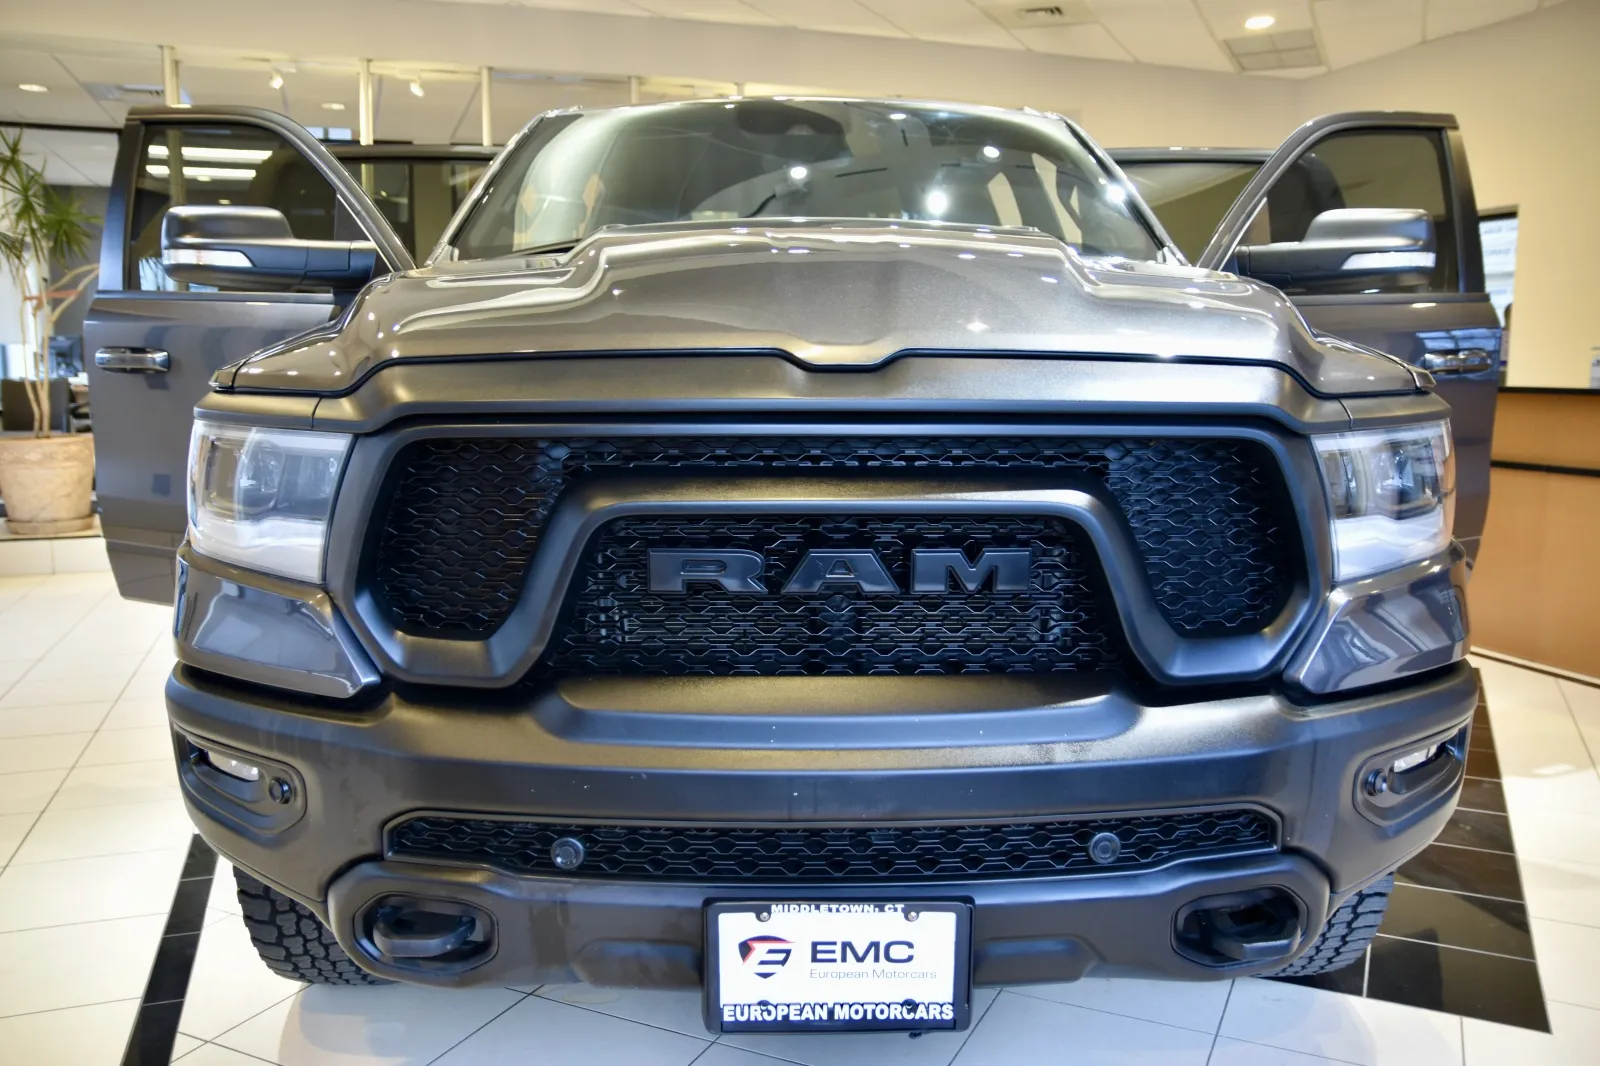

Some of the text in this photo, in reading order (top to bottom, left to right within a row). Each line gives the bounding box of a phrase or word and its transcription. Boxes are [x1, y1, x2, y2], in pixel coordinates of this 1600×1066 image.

[647, 548, 1032, 594] RAM
[884, 904, 905, 913] CT
[810, 940, 915, 964] EMC
[809, 968, 937, 980] European Motorcars
[723, 1002, 954, 1022] EUROPEAN MOTORCARS
